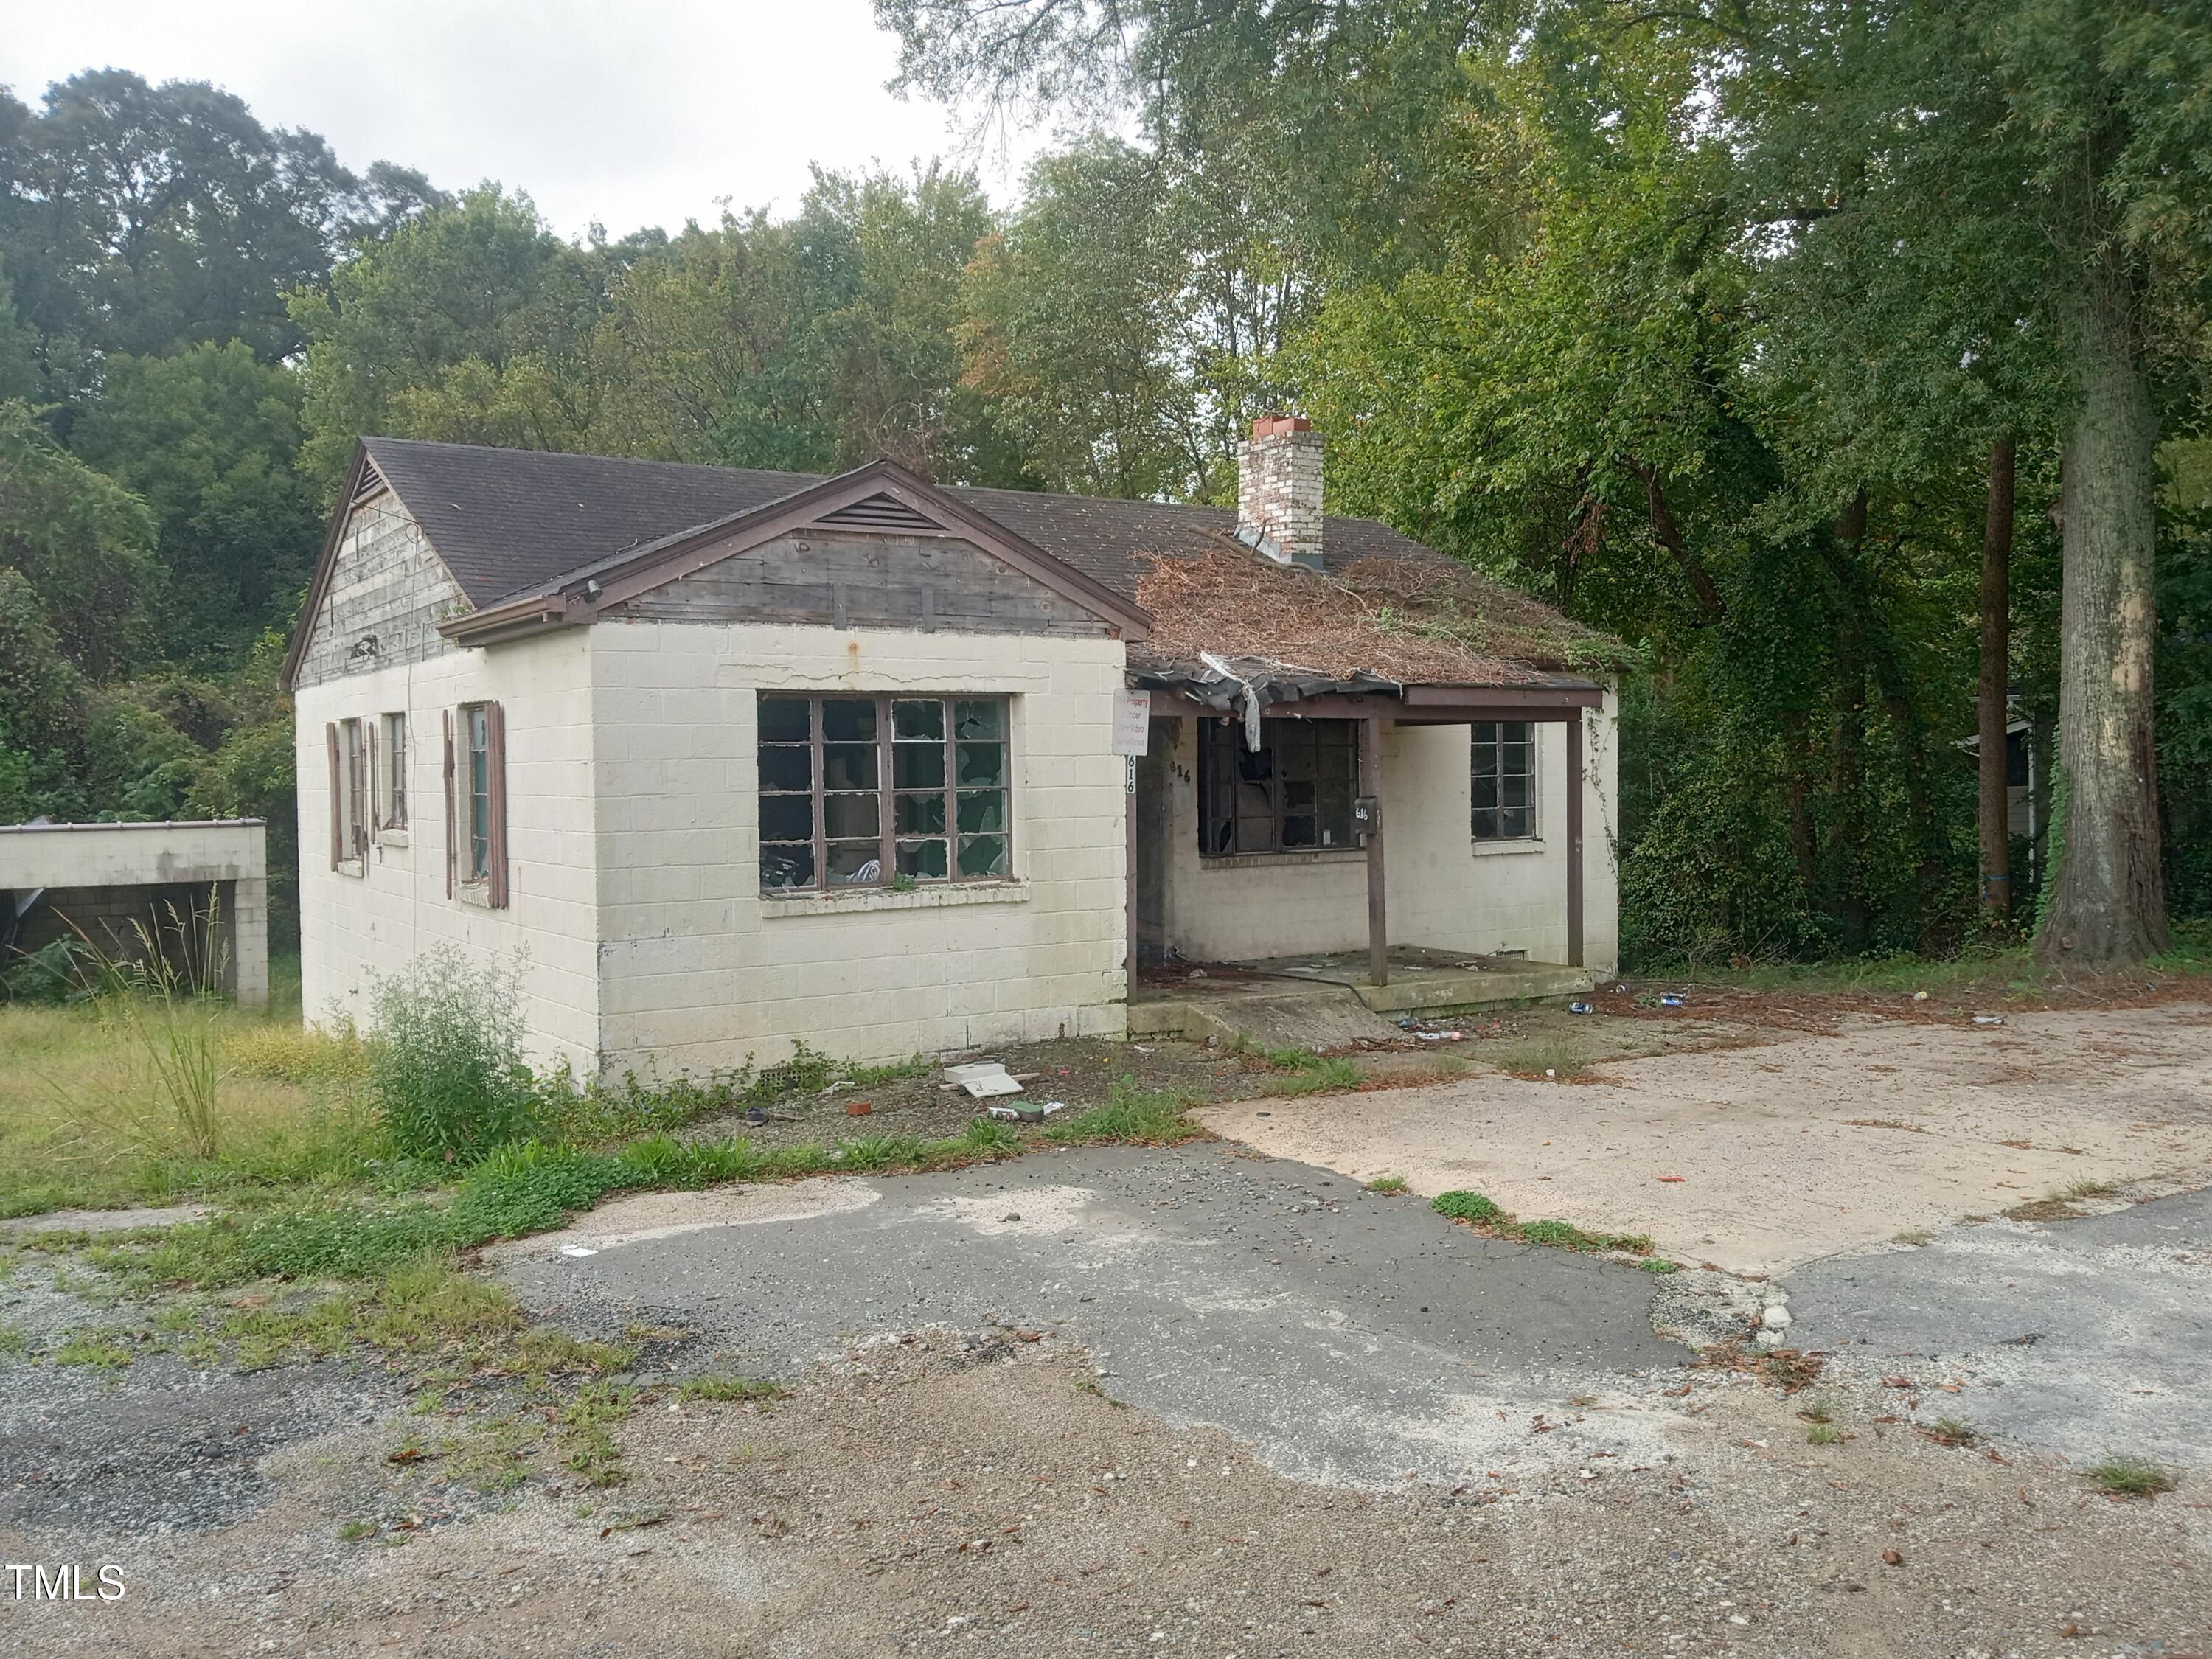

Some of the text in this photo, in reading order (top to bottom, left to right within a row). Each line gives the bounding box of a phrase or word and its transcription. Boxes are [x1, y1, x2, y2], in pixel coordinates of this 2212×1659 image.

[1127, 696, 1148, 708] Property
[1126, 710, 1141, 719] Under
[1170, 761, 1190, 782] 616
[1356, 807, 1368, 821] 616
